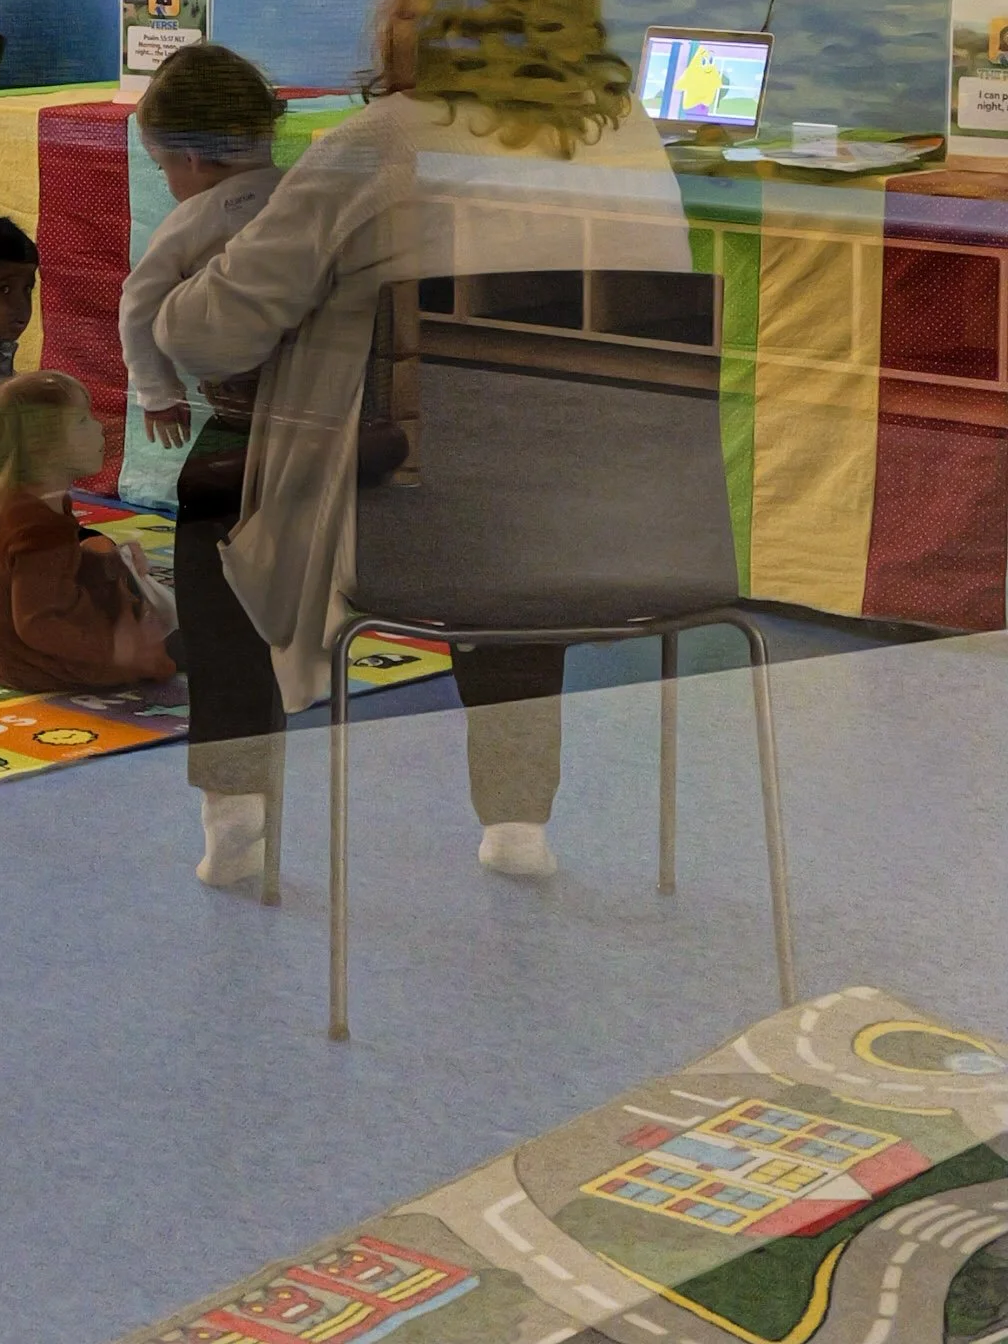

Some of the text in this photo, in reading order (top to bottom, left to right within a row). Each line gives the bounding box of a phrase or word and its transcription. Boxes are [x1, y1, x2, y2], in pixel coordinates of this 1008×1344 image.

[152, 21, 178, 30] VERSE
[979, 90, 982, 98] I
[977, 101, 1004, 113] night,
